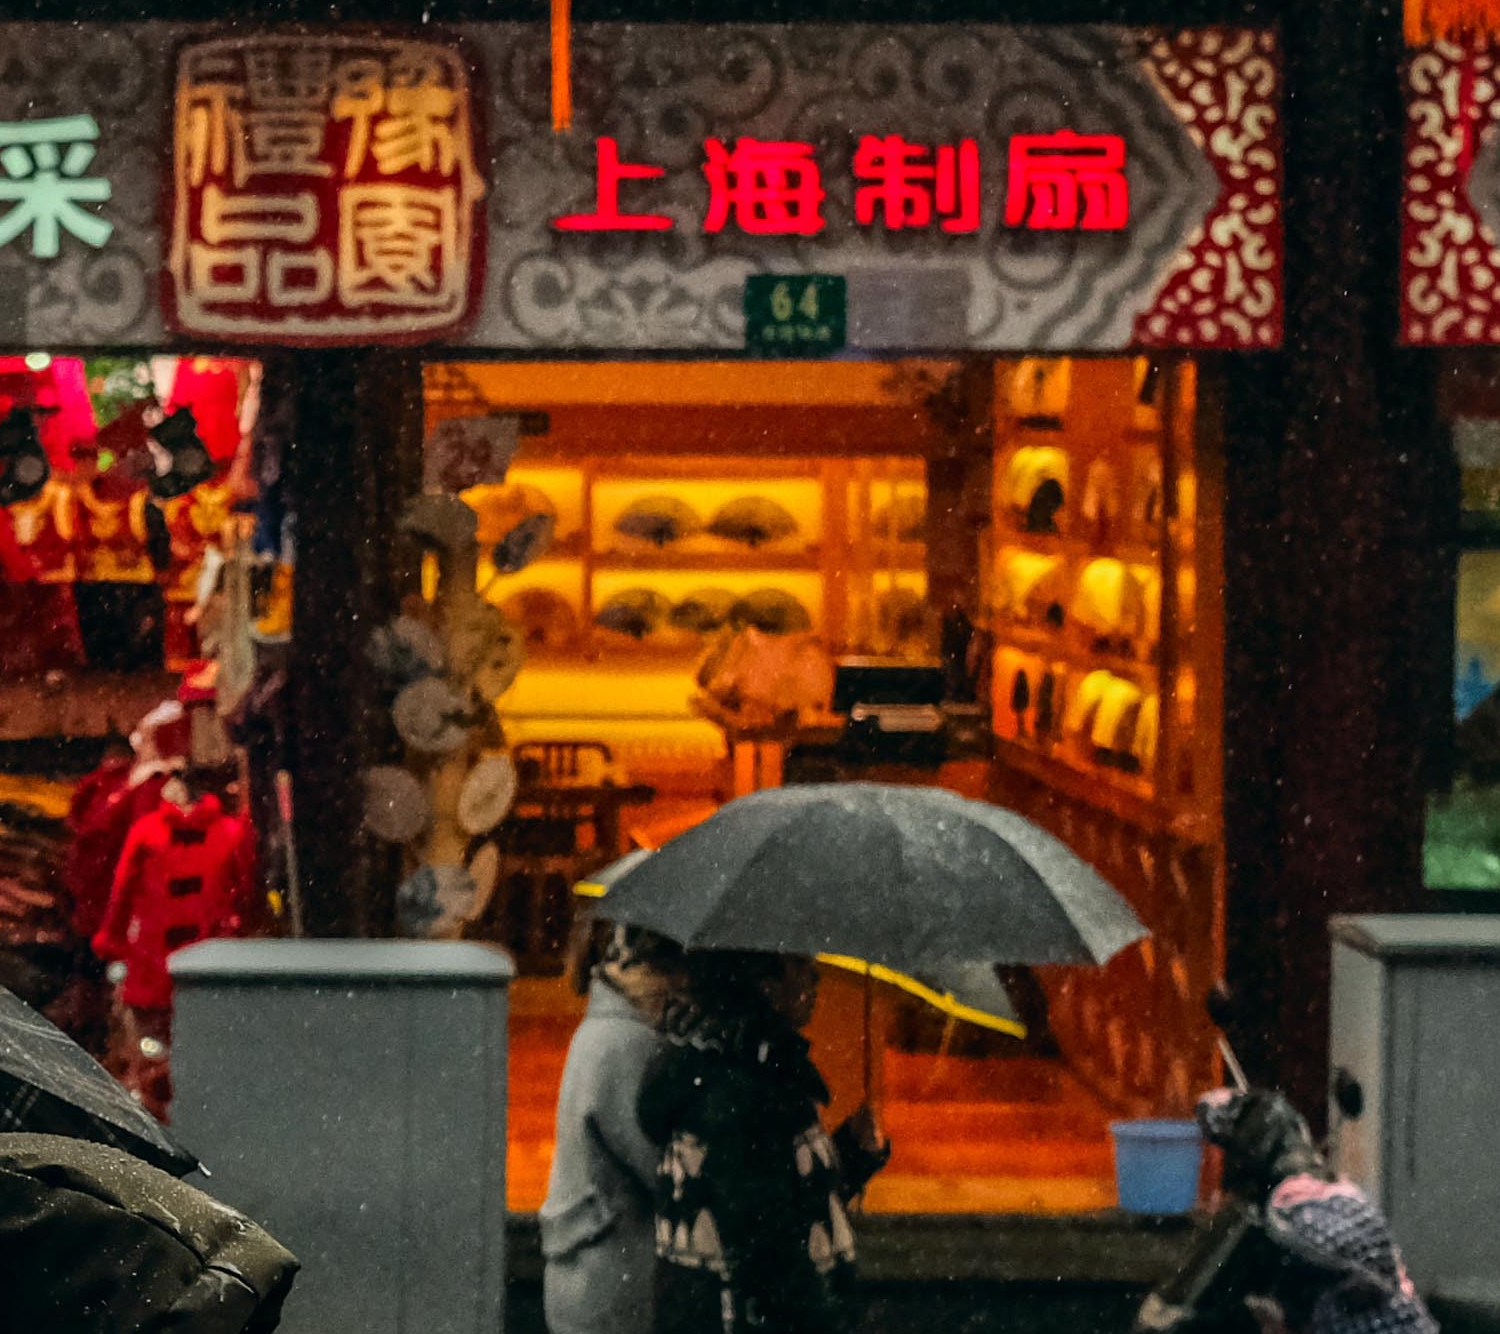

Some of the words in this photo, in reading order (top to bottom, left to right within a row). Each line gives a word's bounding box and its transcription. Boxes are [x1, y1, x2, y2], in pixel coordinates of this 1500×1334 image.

[554, 129, 1130, 235] 上海制扇
[770, 281, 820, 322] 64
